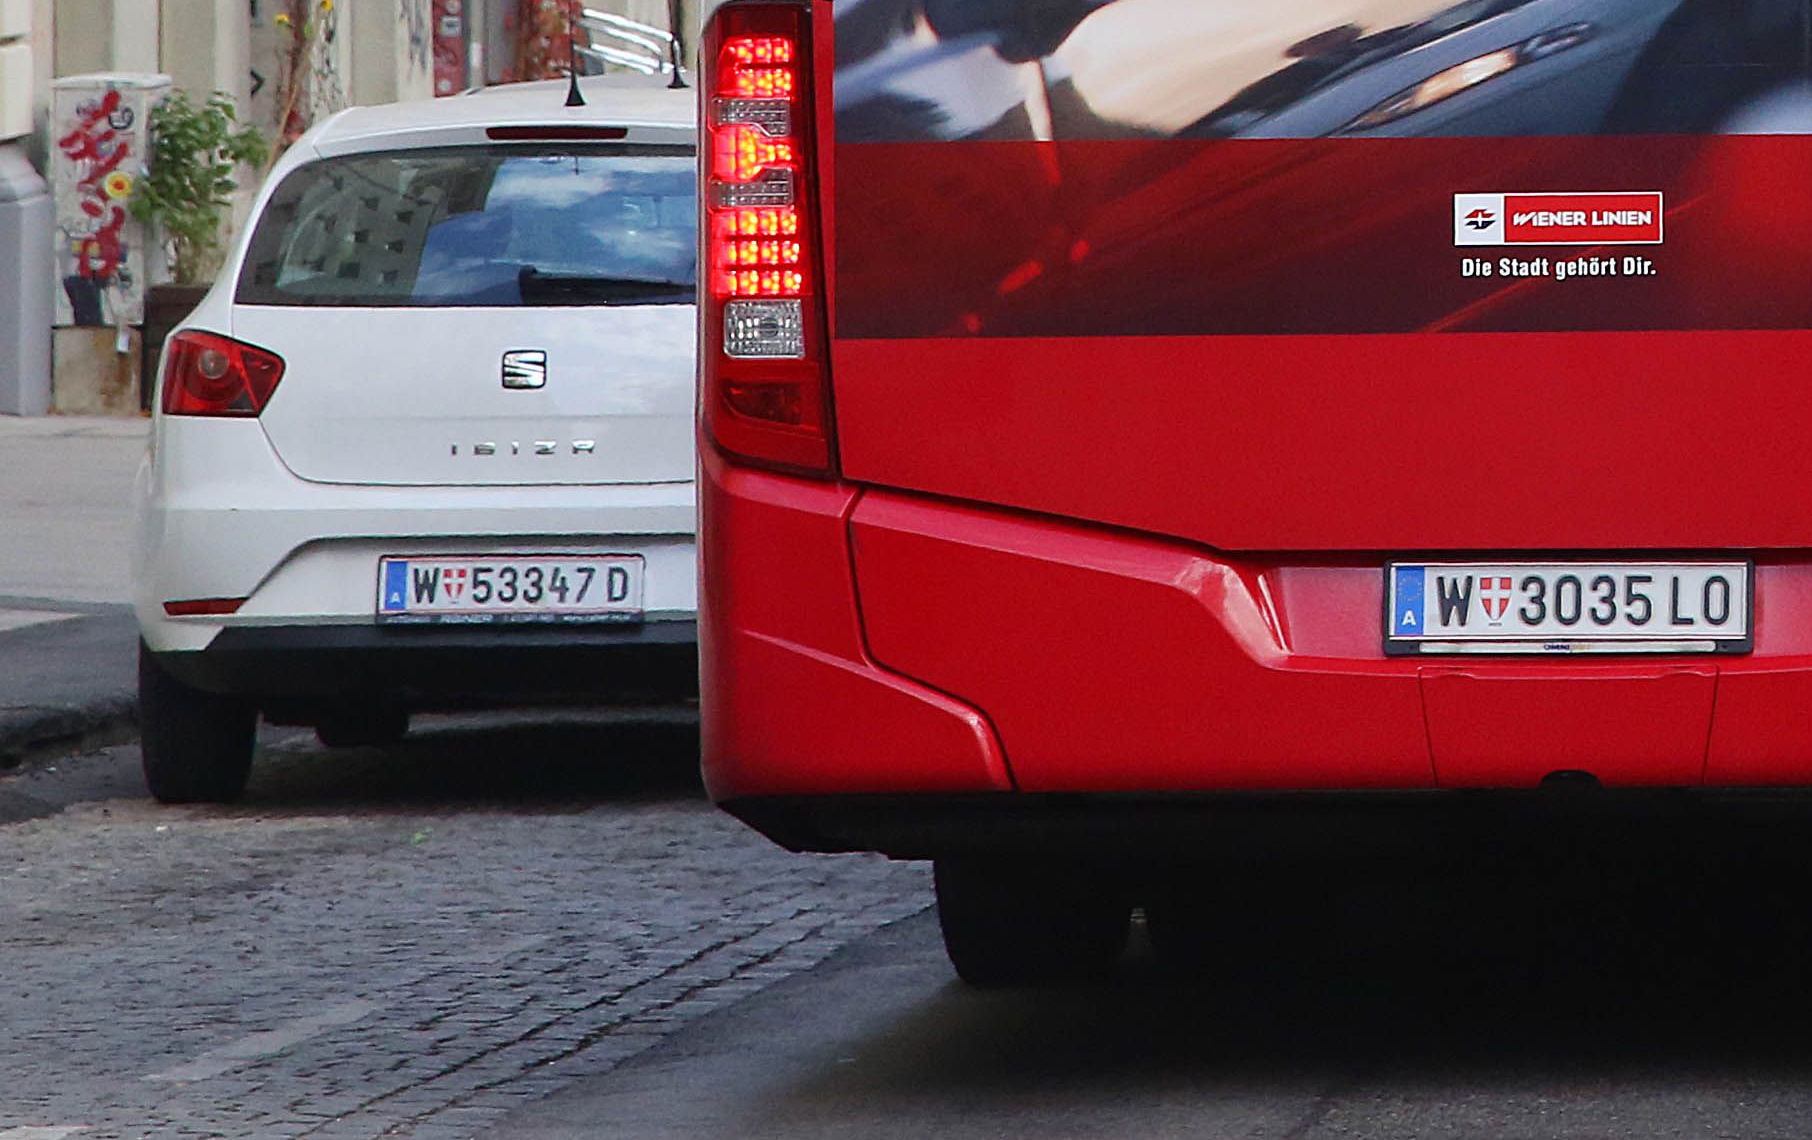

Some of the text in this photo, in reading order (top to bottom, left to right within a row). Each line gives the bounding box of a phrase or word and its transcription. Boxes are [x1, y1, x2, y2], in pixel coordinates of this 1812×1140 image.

[1512, 210, 1652, 227] WIENER LINIEN
[1462, 257, 1657, 280] Die Stadt gehört Dir.
[451, 440, 596, 456] IBIZA
[414, 566, 440, 603] W
[472, 566, 596, 603] 53347
[607, 567, 629, 602] D
[1402, 610, 1416, 626] A
[1437, 575, 1473, 626] W
[1519, 575, 1653, 626] 3035
